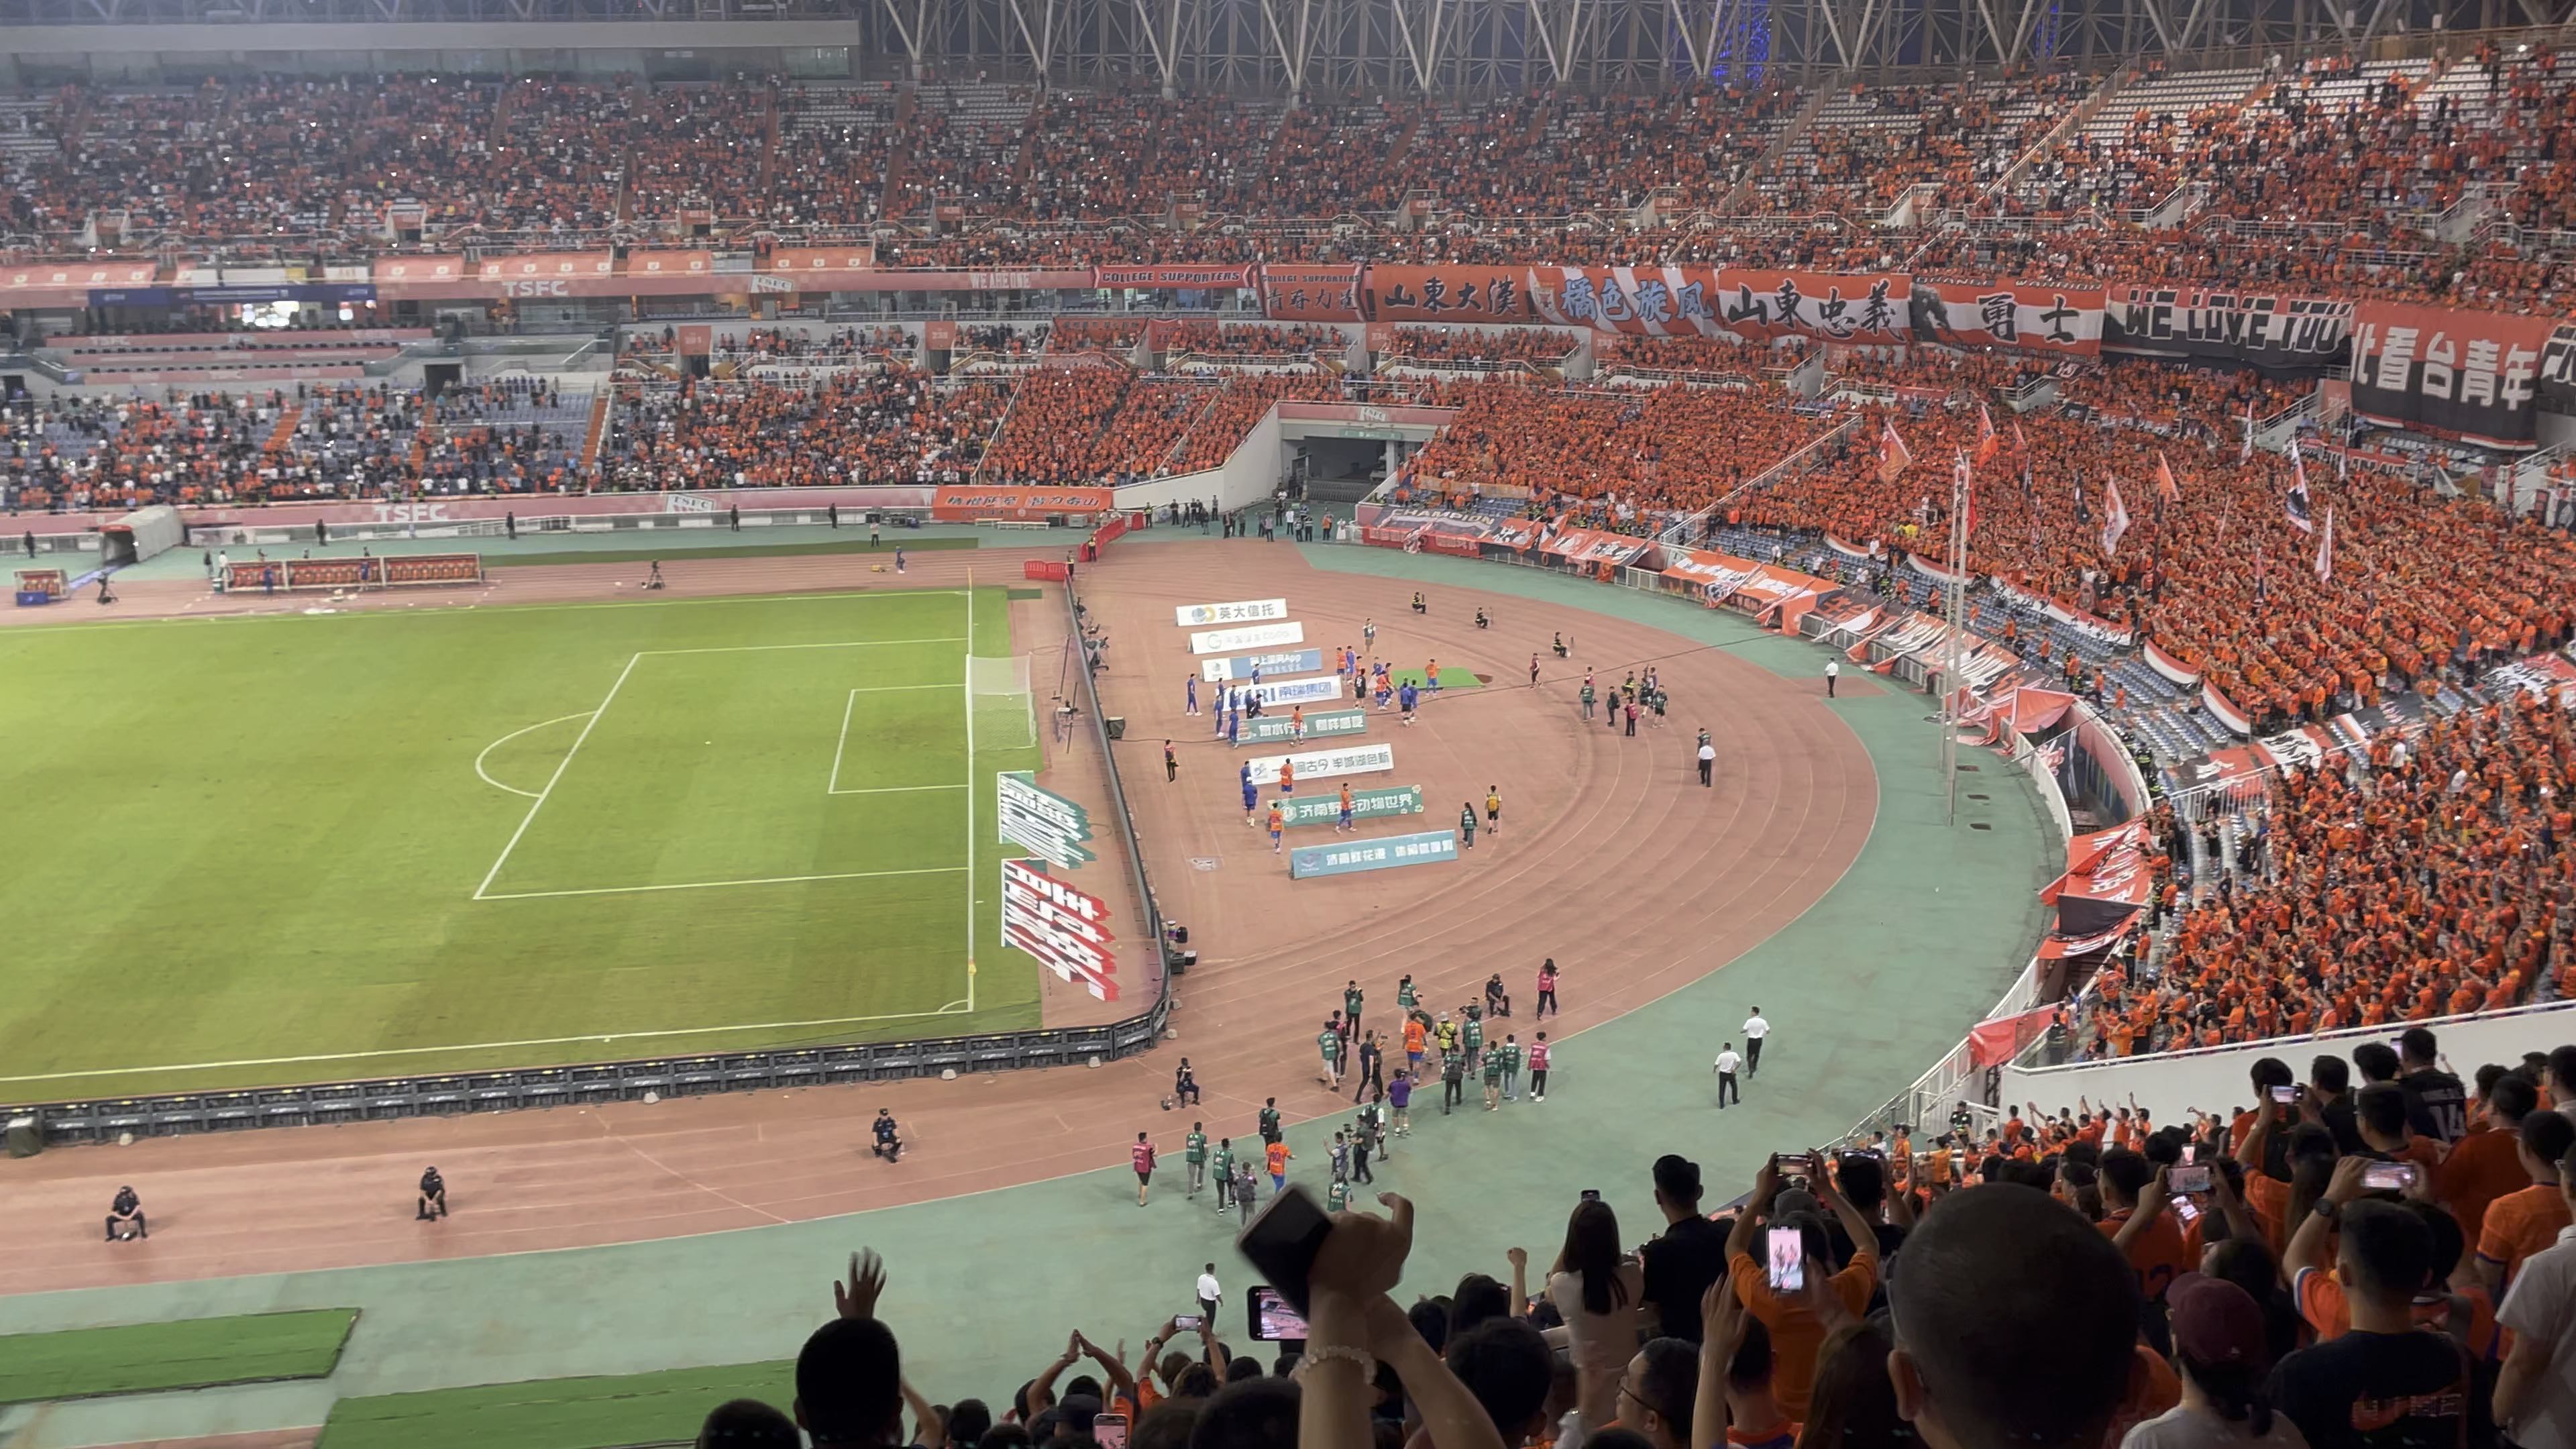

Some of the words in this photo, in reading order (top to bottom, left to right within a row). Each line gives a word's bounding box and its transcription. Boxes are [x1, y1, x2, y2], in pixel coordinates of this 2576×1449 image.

[971, 273, 987, 289] WE
[989, 273, 1010, 289] ARE
[1010, 273, 1030, 289] ONE
[1102, 272, 1155, 282] COLLEGE
[1159, 271, 1240, 282] SUPPORTERS
[1302, 274, 1362, 283] SUPPORTERS
[503, 280, 568, 297] TSFC
[1561, 276, 1715, 322] 橘色旋风
[1727, 278, 1907, 342] 山東忠義
[1978, 292, 2080, 344] 勇士
[2125, 288, 2179, 339] WE
[2186, 288, 2278, 350] LOVE
[2279, 299, 2353, 354] YOU
[2348, 322, 2537, 411] 北看台青年
[375, 504, 447, 521] TSFC
[1393, 508, 1495, 525] CHAMPION
[1218, 604, 1274, 619] 英大信托
[1279, 681, 1332, 697] 南瑞集团
[1272, 759, 1328, 773] 一润古今
